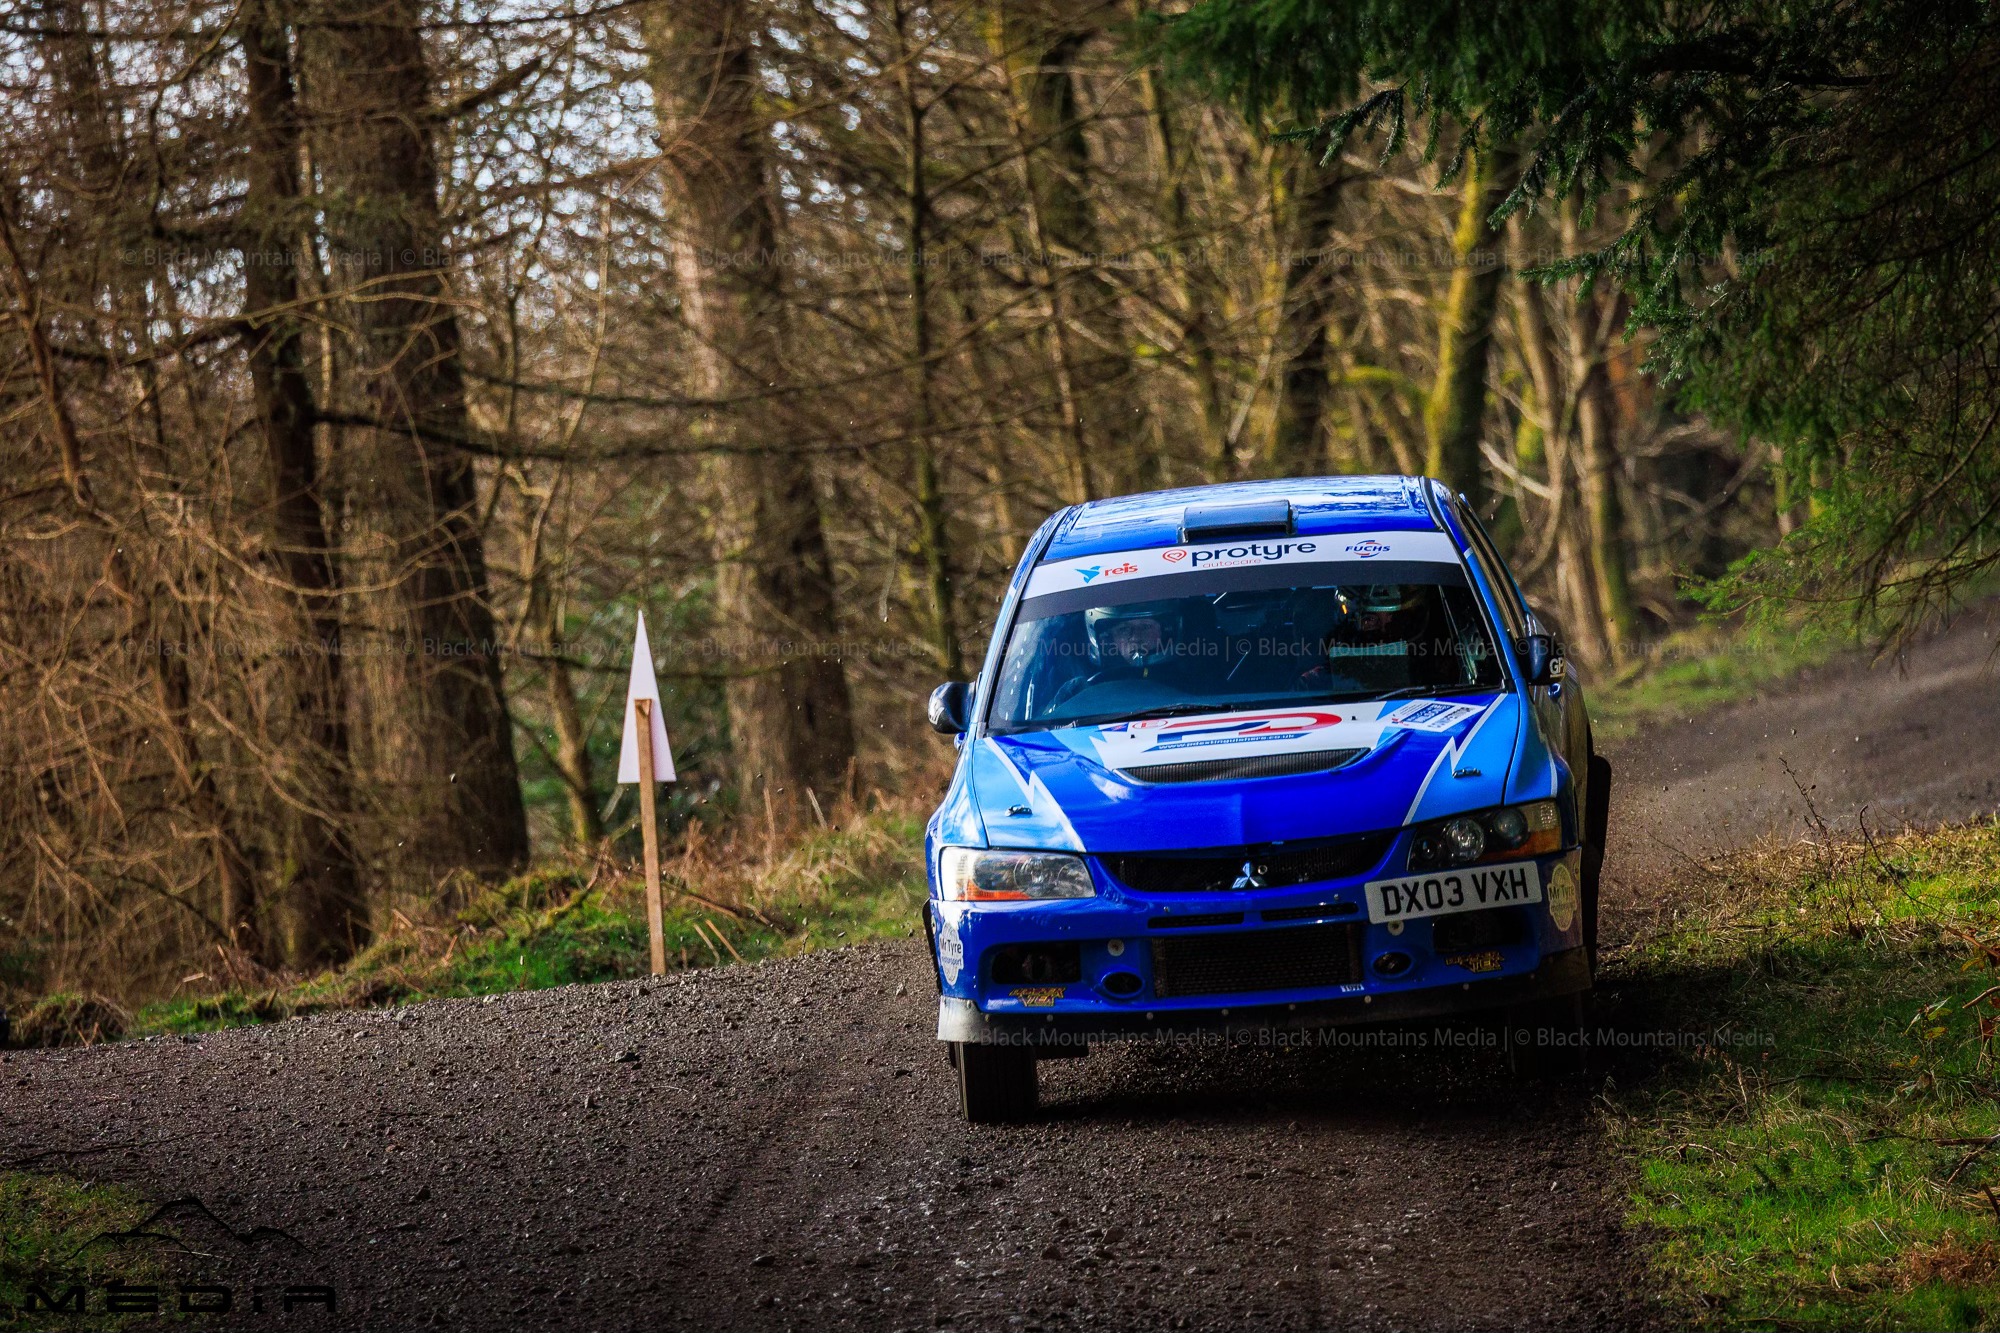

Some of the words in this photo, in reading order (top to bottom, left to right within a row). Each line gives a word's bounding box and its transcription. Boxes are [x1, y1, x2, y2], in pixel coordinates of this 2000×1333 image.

[1191, 542, 1317, 567] protyre
[1202, 558, 1262, 569] autocare
[1104, 562, 1139, 577] reis
[1380, 876, 1464, 916] DX03
[1471, 868, 1529, 903] VXH
